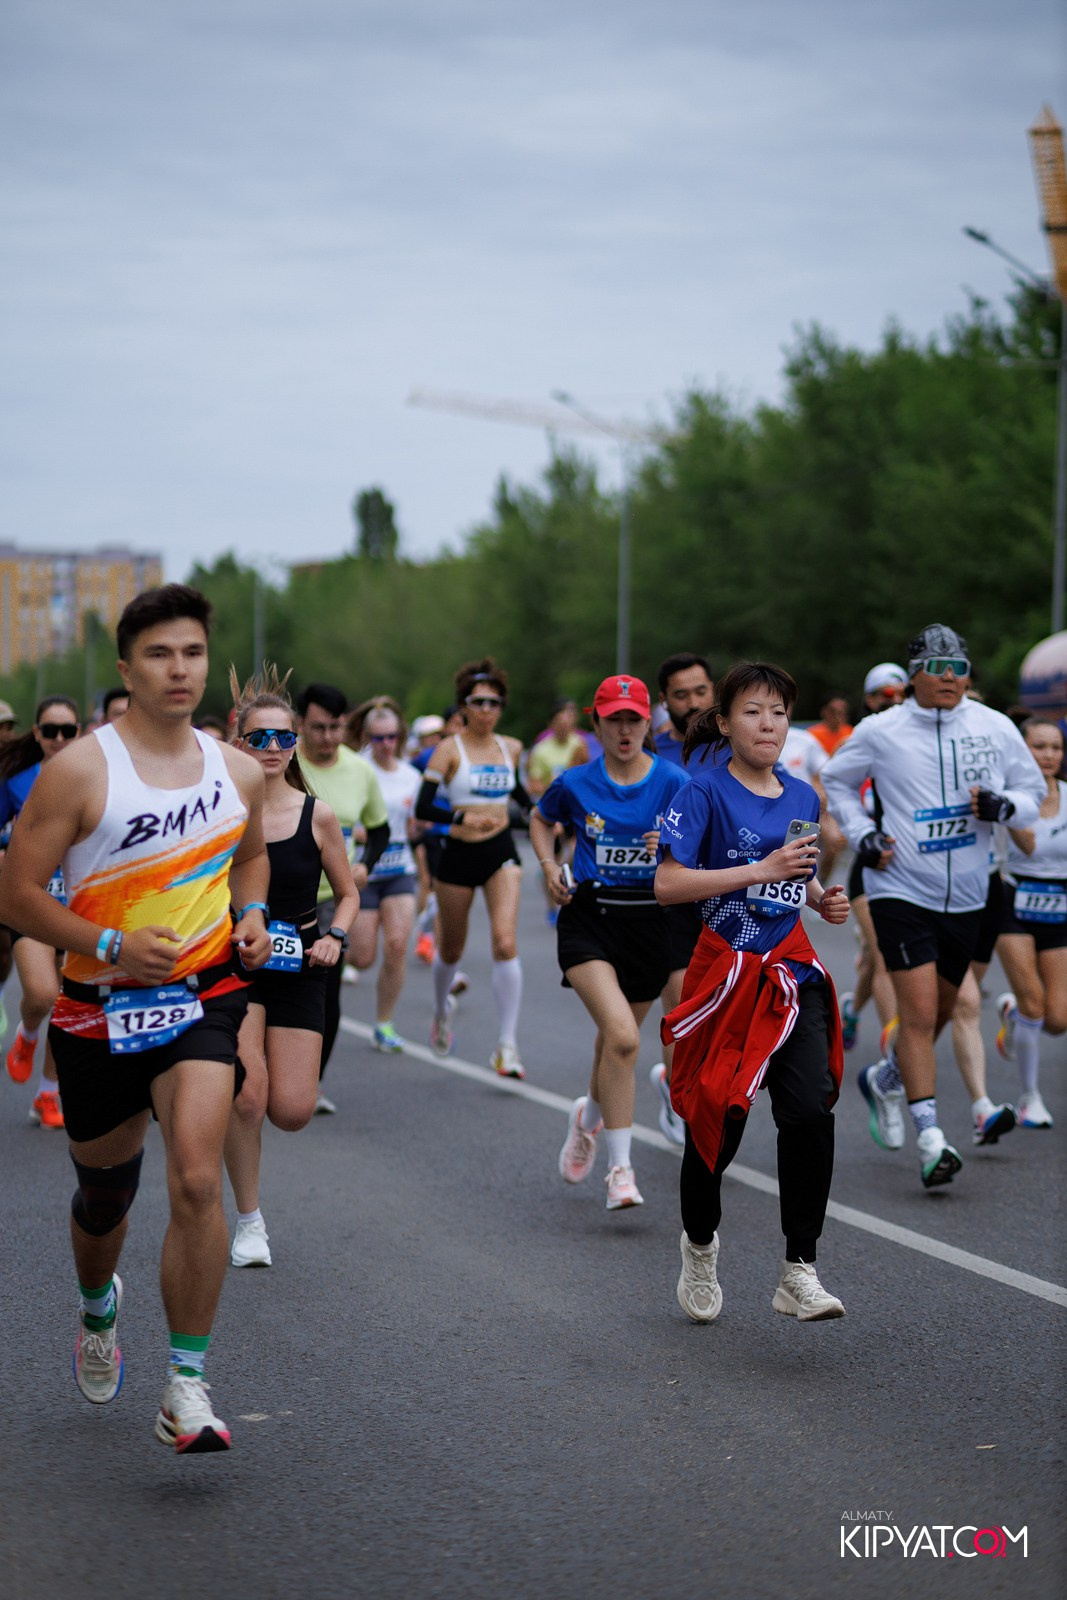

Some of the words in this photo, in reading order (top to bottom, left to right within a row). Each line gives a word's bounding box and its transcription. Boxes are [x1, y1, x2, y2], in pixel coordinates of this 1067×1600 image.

[928, 818, 967, 838] 1172
[605, 848, 652, 864] 1874
[759, 882, 803, 905] 1565
[272, 937, 296, 955] 65
[120, 1007, 187, 1034] 1128
